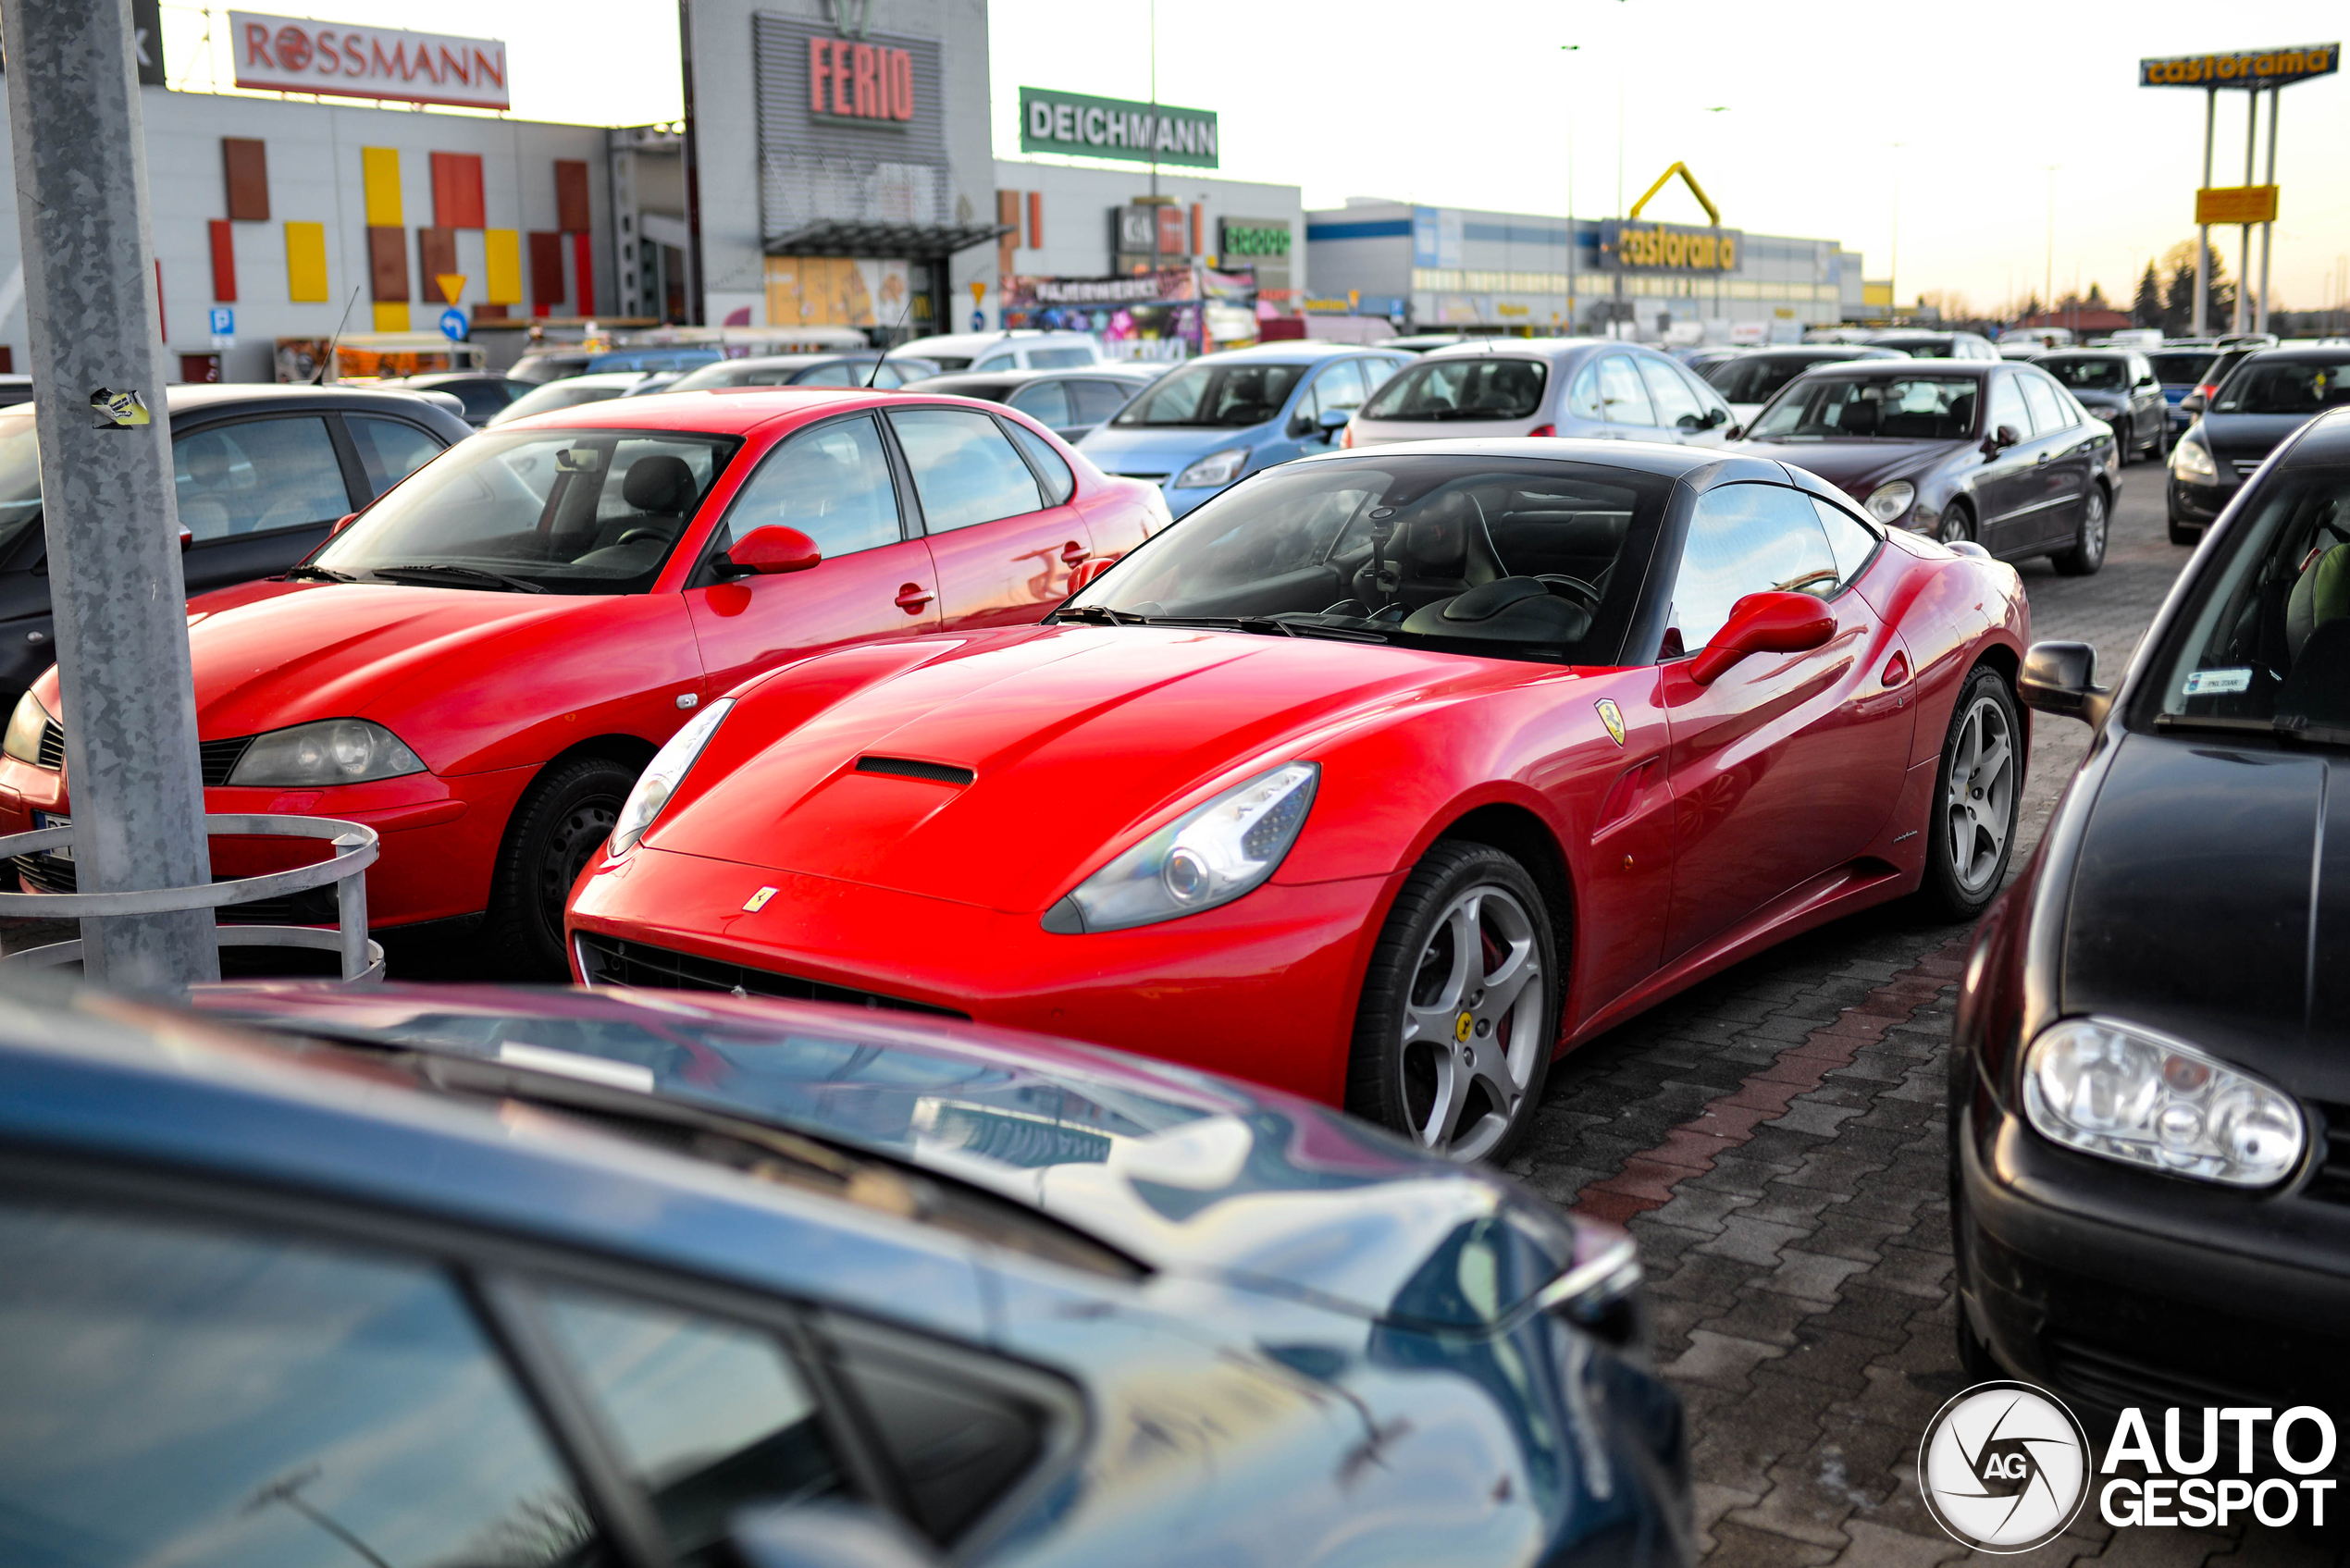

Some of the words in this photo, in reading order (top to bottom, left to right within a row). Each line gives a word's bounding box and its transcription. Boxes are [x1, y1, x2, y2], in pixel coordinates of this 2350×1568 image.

[244, 21, 504, 90] ROSSMANN
[810, 36, 914, 120] FERIO
[2147, 49, 2329, 83] castorama
[1029, 100, 1217, 156] DEICHMANN
